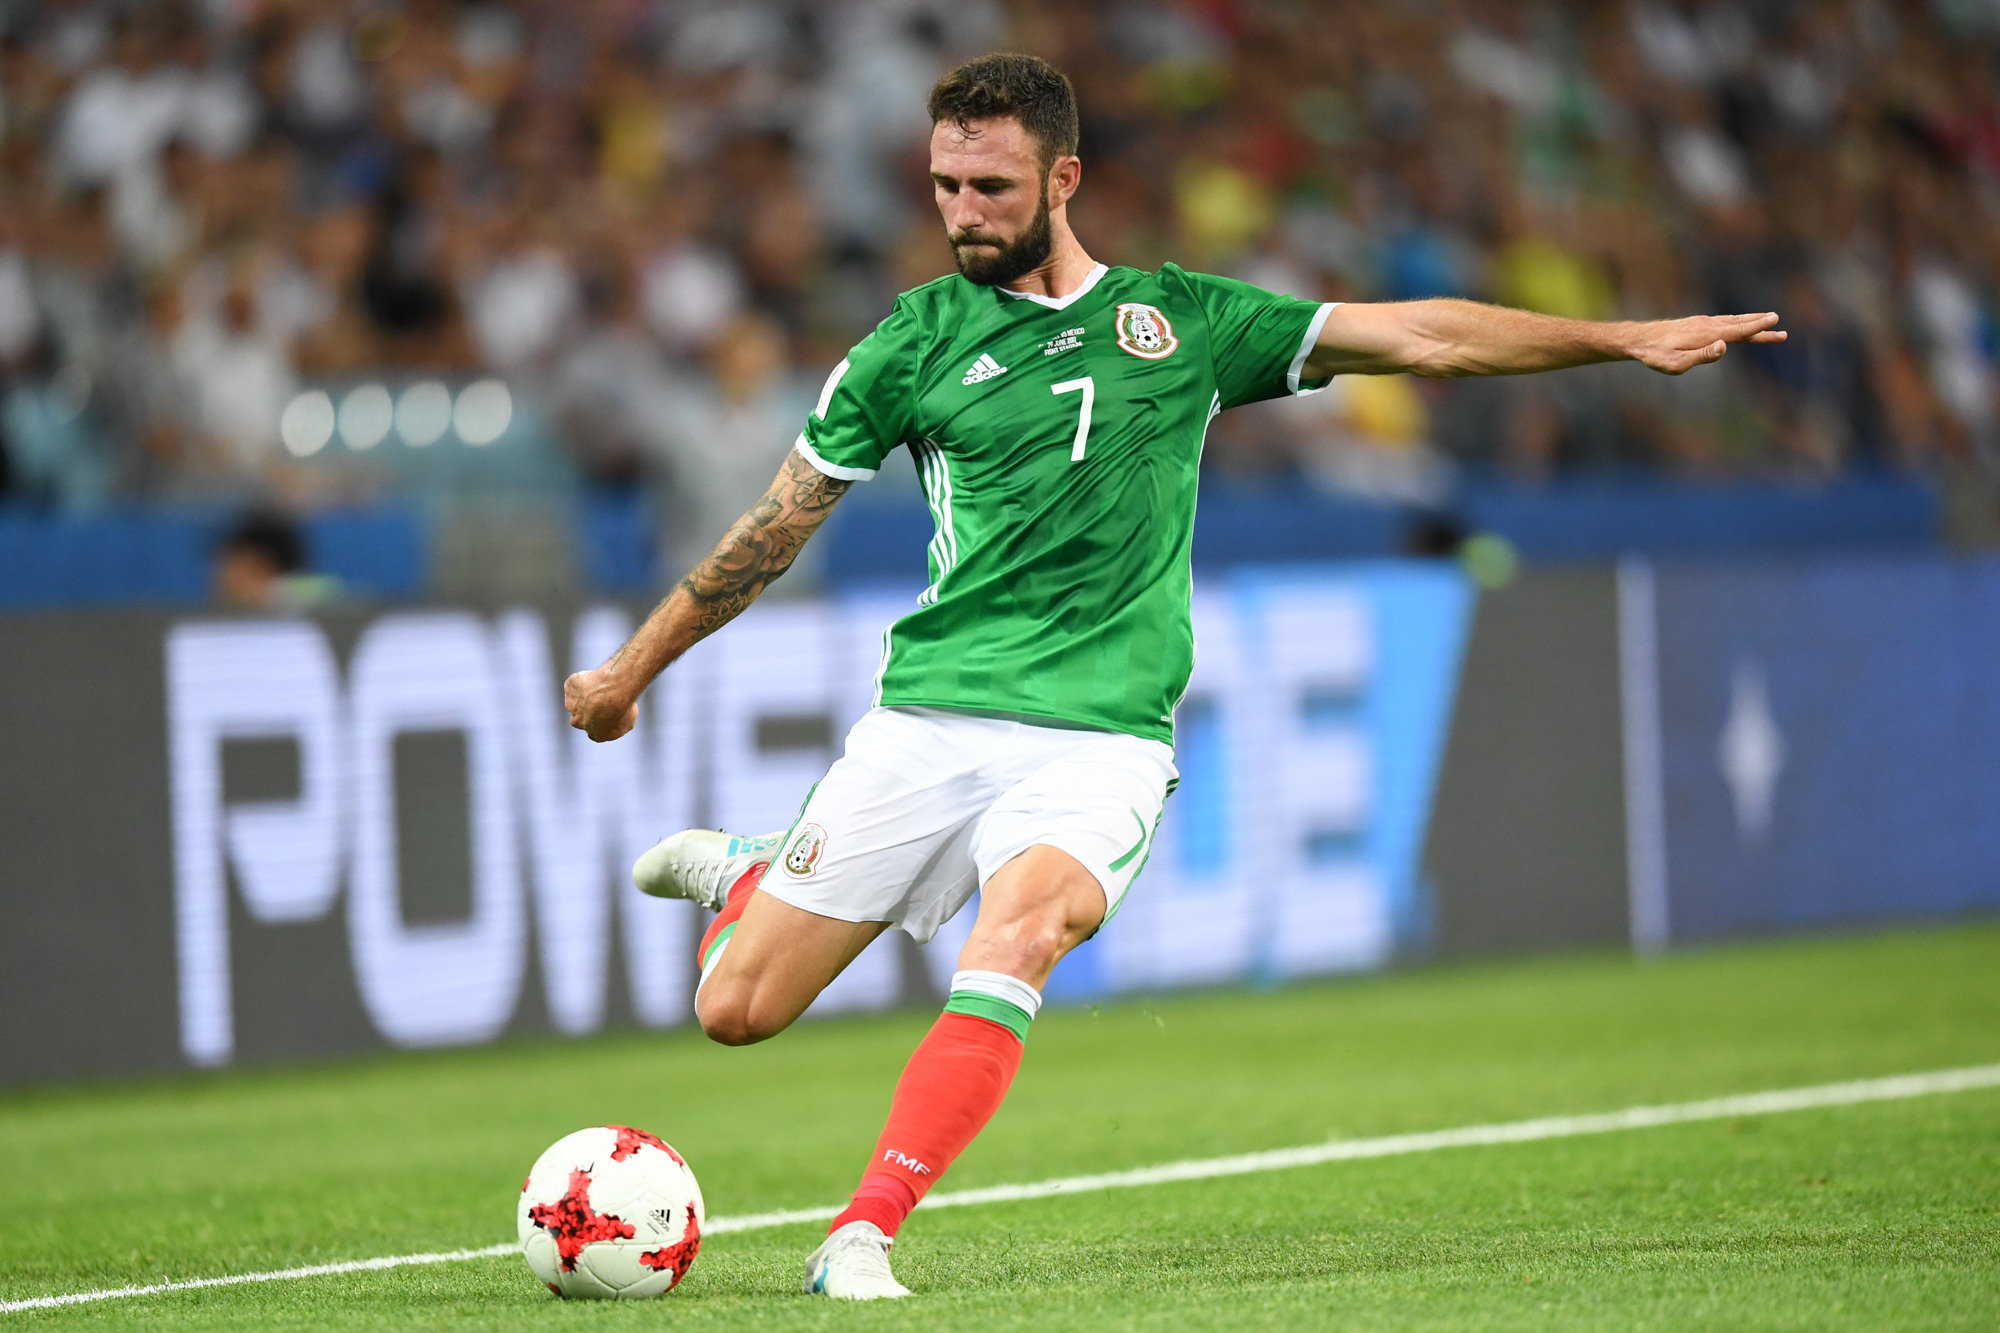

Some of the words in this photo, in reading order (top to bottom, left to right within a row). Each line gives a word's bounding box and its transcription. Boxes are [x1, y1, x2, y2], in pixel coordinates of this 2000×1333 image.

[1066, 327, 1085, 336] MEXICO
[1053, 338, 1067, 347] JUNE
[962, 366, 1008, 386] adidas
[1050, 376, 1095, 462] 7
[883, 1149, 931, 1175] FMF
